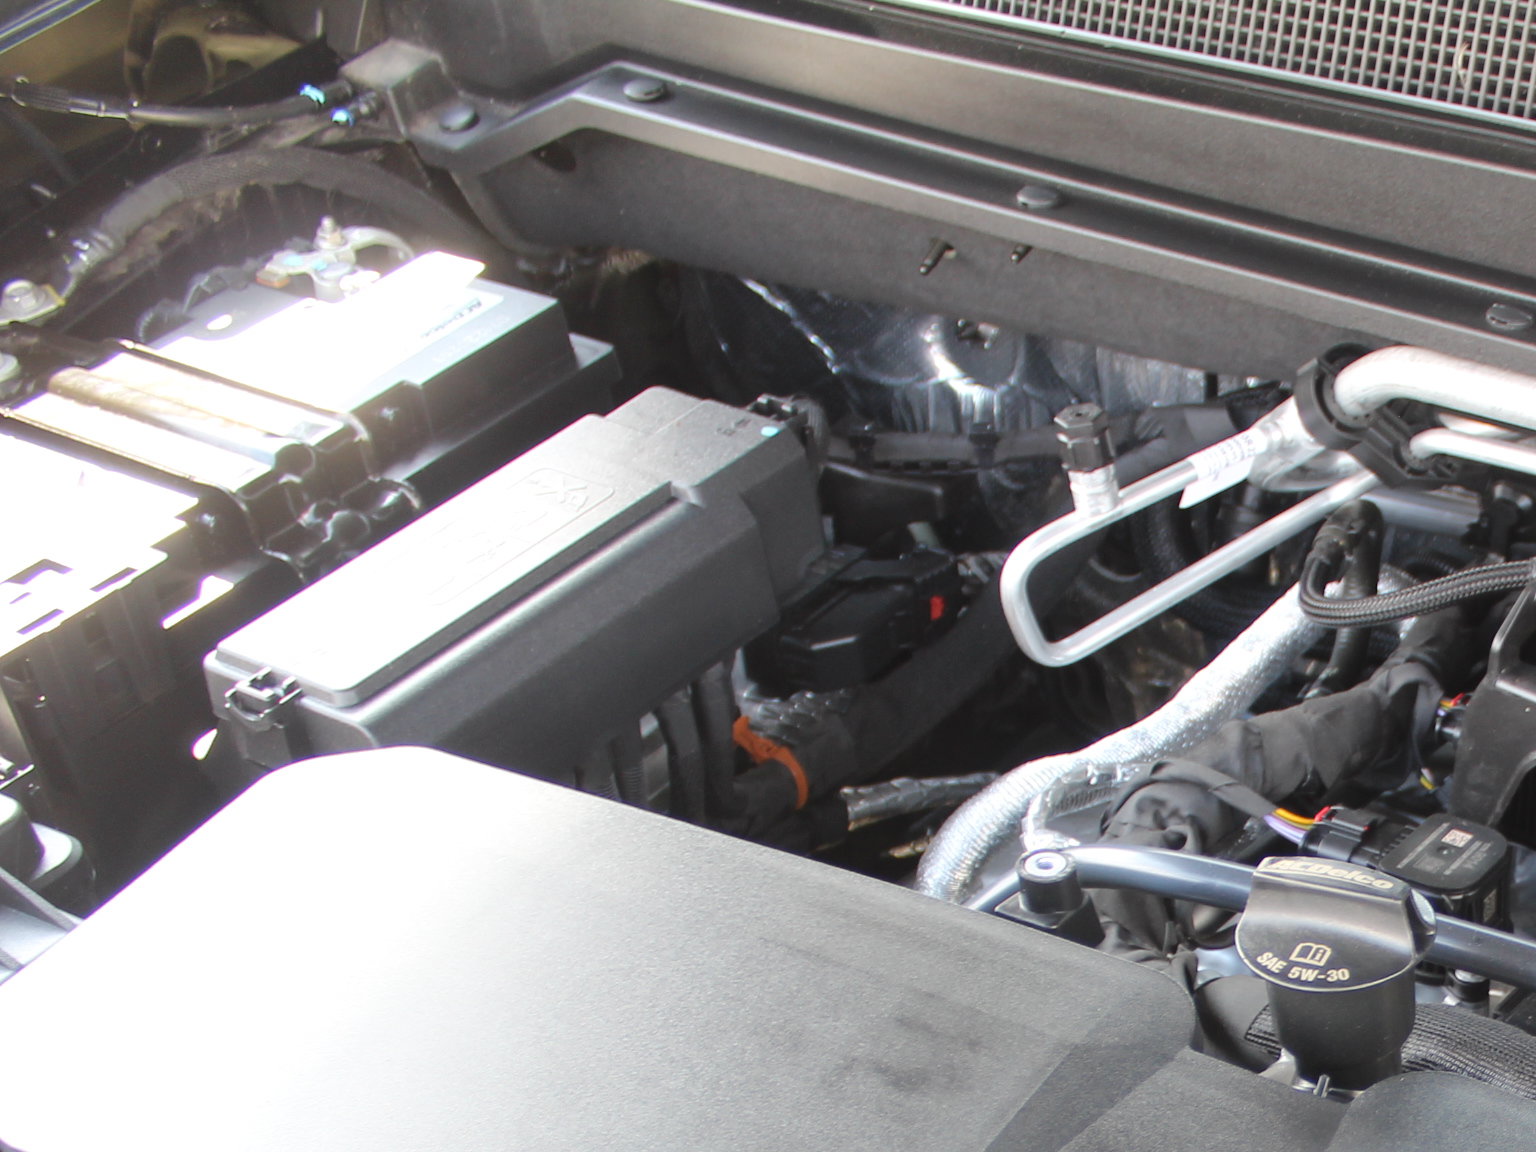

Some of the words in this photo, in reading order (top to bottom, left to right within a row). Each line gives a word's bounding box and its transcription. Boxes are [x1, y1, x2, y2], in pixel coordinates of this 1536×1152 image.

[1268, 859, 1395, 890] ACDelco
[1256, 951, 1288, 974] SAE
[1288, 966, 1350, 983] 5W-30
